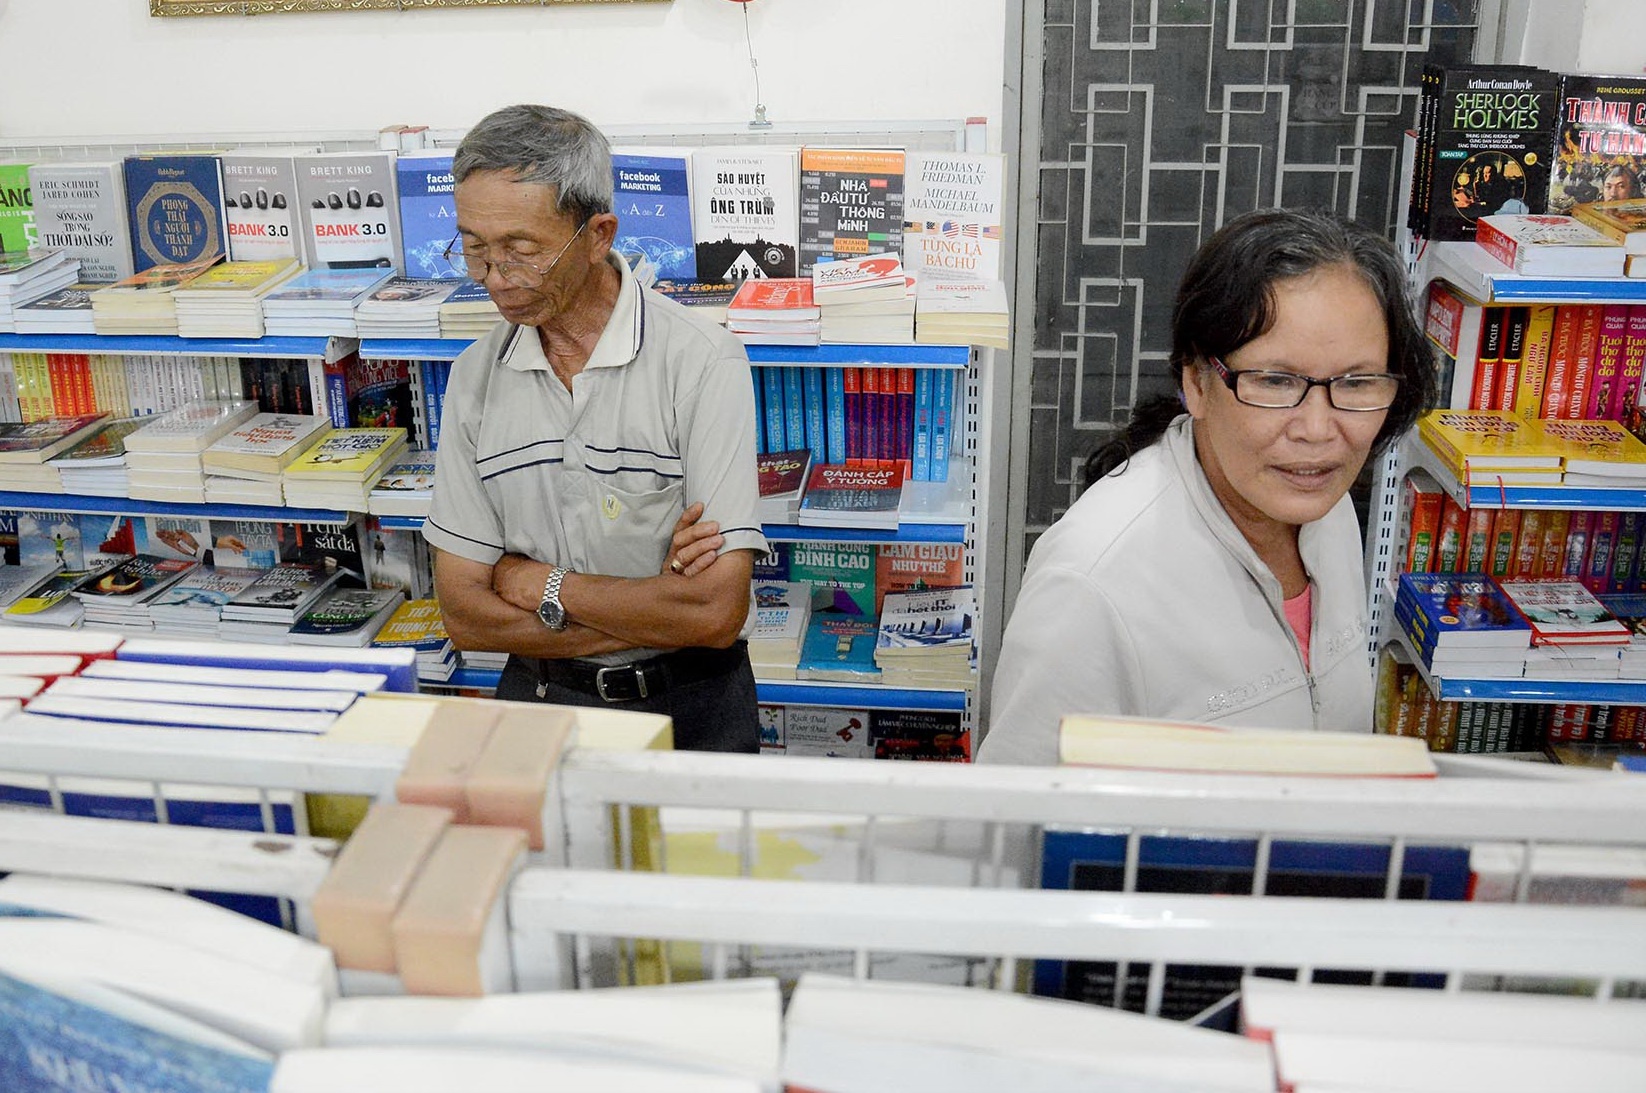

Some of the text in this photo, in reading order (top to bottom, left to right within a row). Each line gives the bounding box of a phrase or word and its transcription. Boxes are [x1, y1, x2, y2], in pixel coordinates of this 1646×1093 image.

[1467, 79, 1532, 92] Arthur Conan Doyle
[1455, 93, 1541, 110] SHERLOCK
[1566, 96, 1631, 124] THÀNH
[1453, 109, 1540, 129] HOLMES
[1579, 129, 1606, 154] TƯ
[225, 165, 278, 175] BRETT KING
[310, 165, 372, 176] BRETT KING
[922, 160, 986, 174] THOMAS L.
[620, 170, 661, 182] facebook
[738, 172, 765, 185] HUYỆT
[921, 173, 984, 185] FRIEDMAN
[39, 181, 100, 189] ERIC SCHMIDT
[620, 182, 661, 192] MARKETING
[840, 179, 868, 192] NHÀ
[43, 190, 100, 199] JARED COHEN
[924, 188, 978, 201] MICHAEL
[161, 199, 188, 210] PHONG
[630, 203, 665, 217] A Z
[711, 197, 735, 214] ÔNG
[909, 199, 994, 214] MANDELBAUM
[438, 206, 449, 218] A
[839, 206, 885, 219] THÔNG
[63, 223, 90, 232] TRONG
[229, 223, 289, 237] BANK 3.0
[315, 223, 386, 237] BANK 3.0
[920, 237, 983, 255] TỪNG LÀ
[925, 253, 943, 265] BÁ
[823, 470, 863, 479] ĐÁNH
[315, 533, 336, 550] sắt
[837, 554, 870, 570] CAO
[852, 582, 866, 590] TOP
[790, 713, 827, 723] Rich Dad
